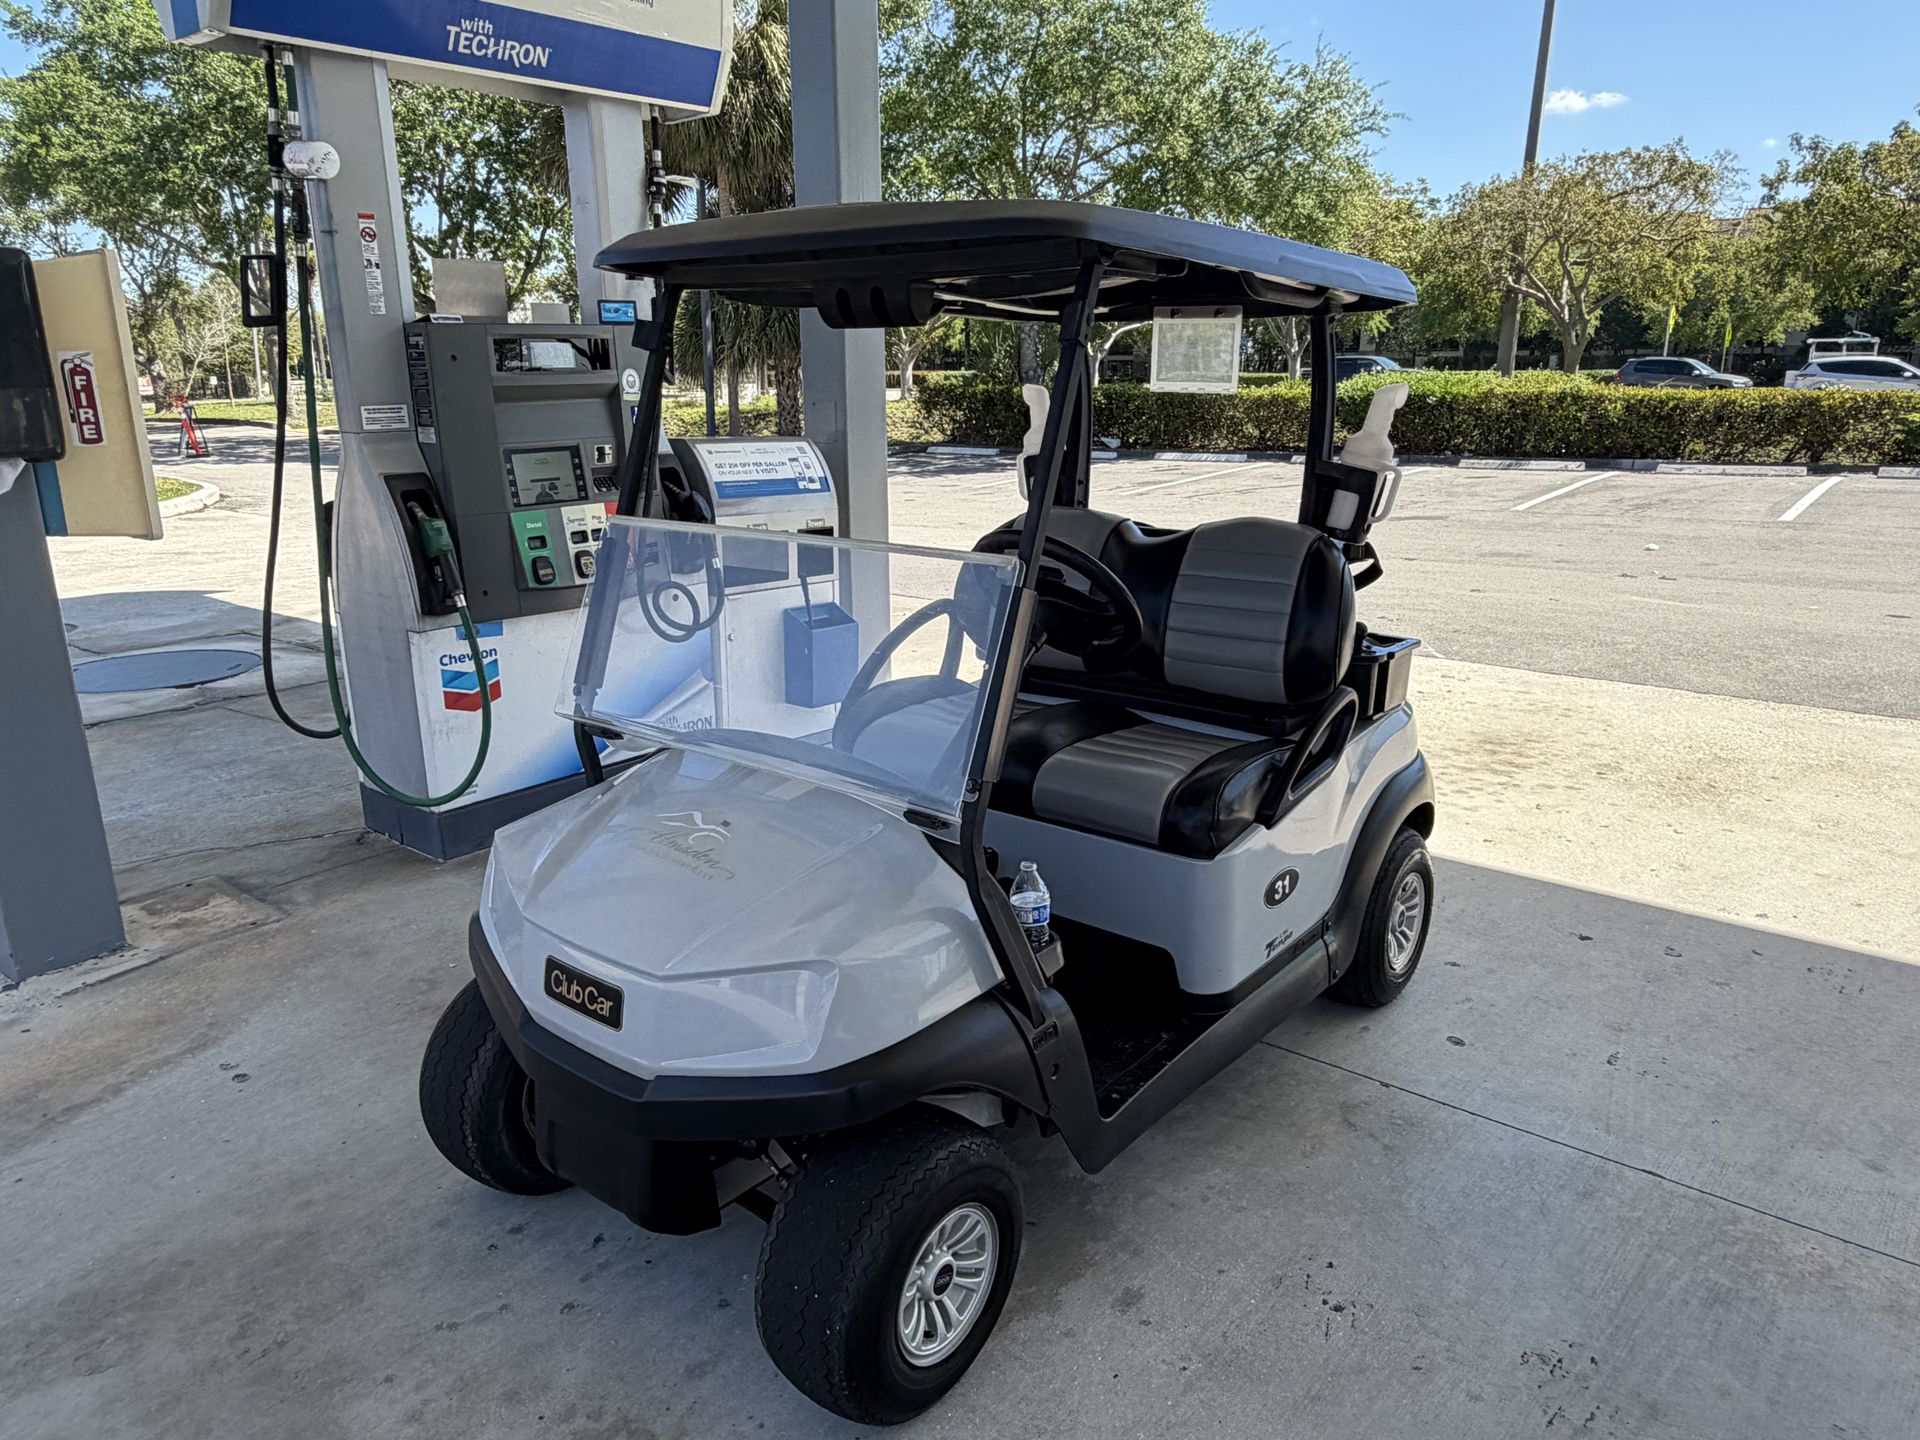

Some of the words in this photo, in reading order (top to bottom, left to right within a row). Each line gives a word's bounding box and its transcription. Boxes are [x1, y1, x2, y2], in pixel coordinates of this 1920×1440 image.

[461, 18, 493, 35] with
[446, 25, 549, 68] TECHRON
[74, 376, 98, 439] FIRE
[764, 460, 787, 468] GALLON
[439, 647, 498, 666] Chevon
[1274, 874, 1290, 901] 31
